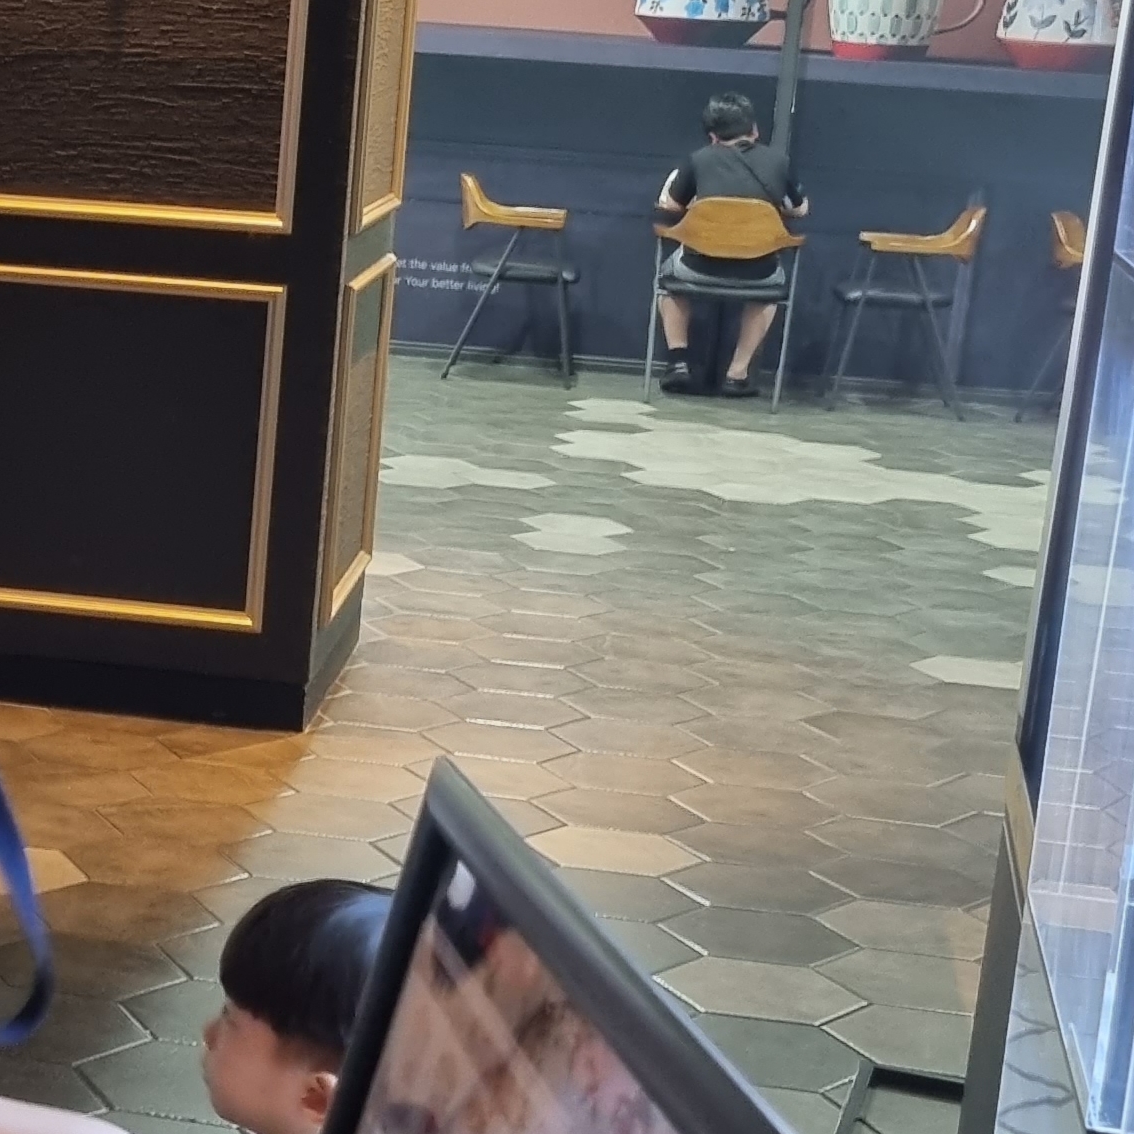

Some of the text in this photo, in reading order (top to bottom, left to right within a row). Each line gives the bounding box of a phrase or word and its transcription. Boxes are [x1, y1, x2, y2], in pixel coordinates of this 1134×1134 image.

[409, 257, 428, 270] the
[430, 260, 459, 273] value
[460, 262, 472, 273] fo
[431, 277, 464, 290] better
